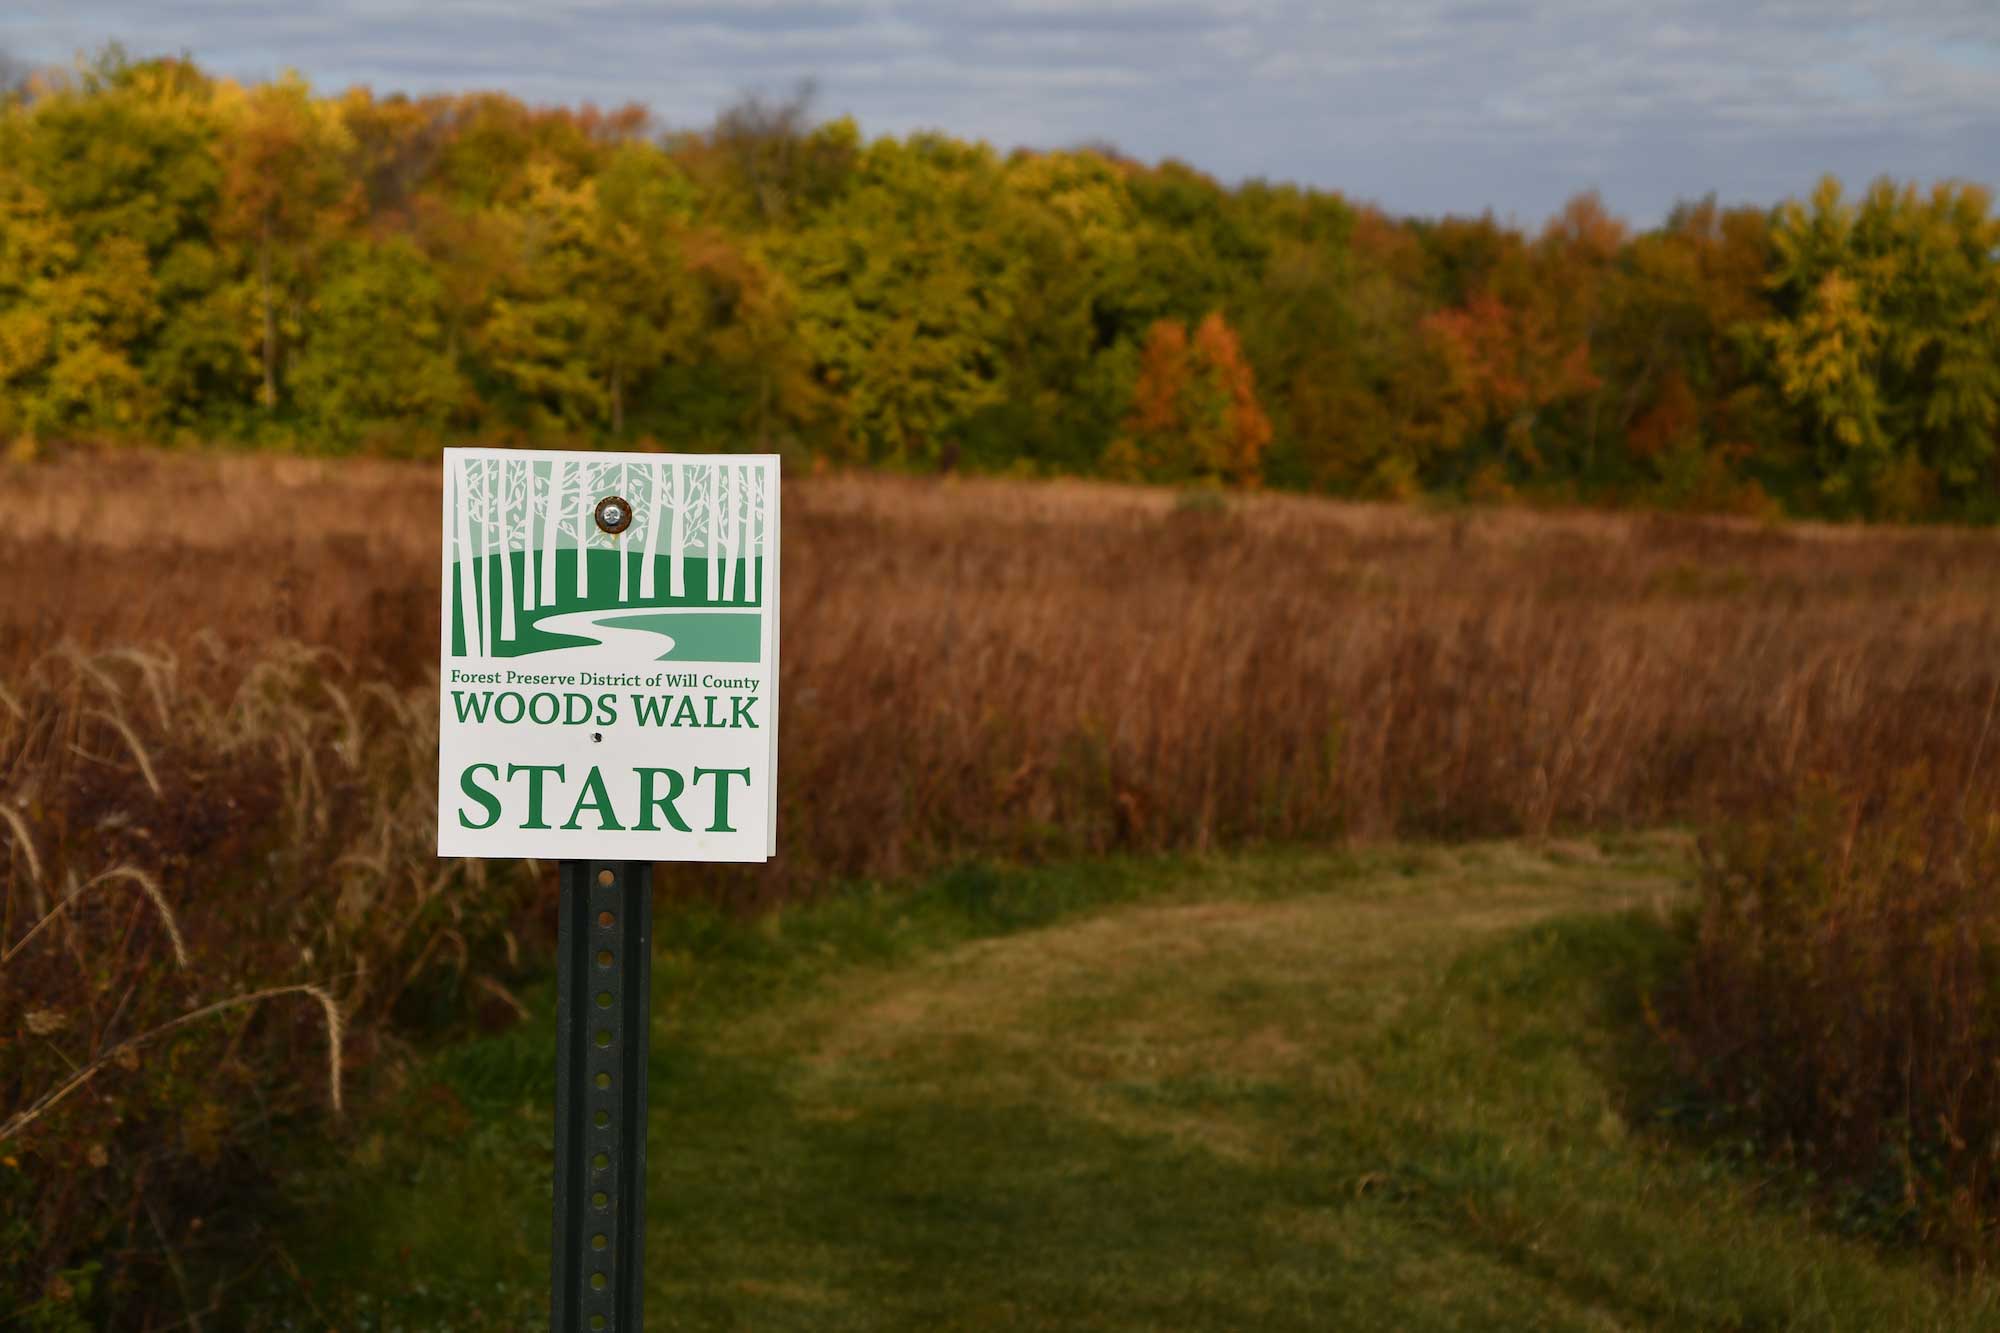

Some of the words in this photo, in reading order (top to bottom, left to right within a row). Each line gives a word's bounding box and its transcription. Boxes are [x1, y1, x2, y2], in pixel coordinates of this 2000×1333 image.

[452, 670, 501, 683] Forest
[507, 671, 575, 685] Preserve
[580, 673, 640, 686] District
[646, 674, 662, 686] of
[666, 674, 697, 687] Will
[703, 675, 759, 693] County
[451, 691, 617, 726] WOODS
[631, 695, 759, 728] WALK
[459, 763, 750, 832] START
